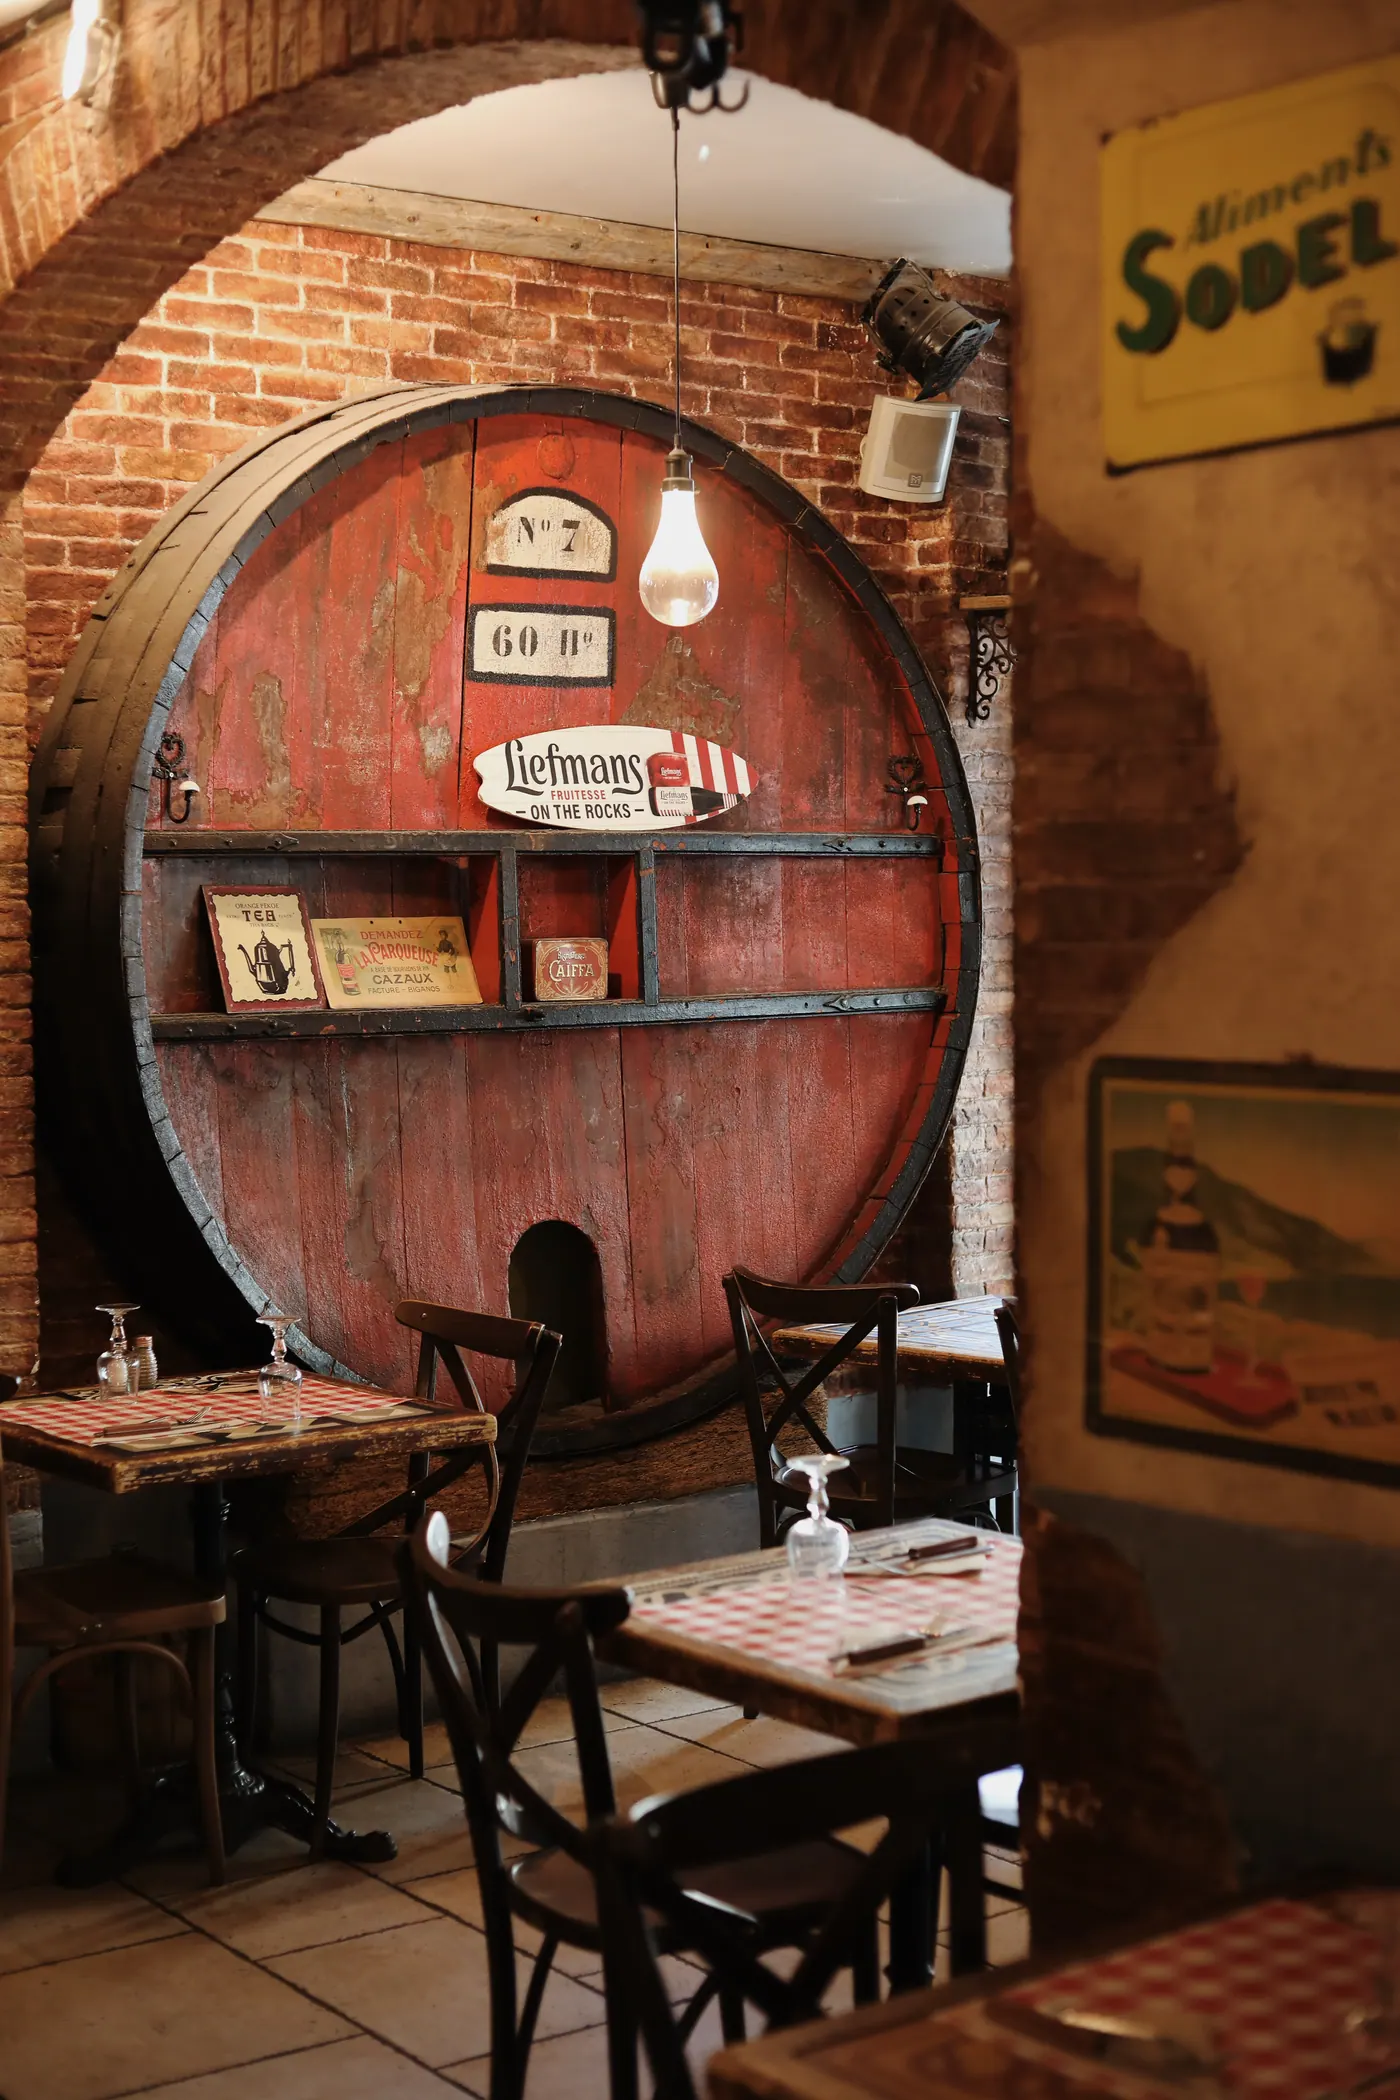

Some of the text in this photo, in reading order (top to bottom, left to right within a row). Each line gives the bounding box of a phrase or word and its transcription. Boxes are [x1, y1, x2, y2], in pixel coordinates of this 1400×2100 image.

[1184, 128, 1392, 251] Aliments
[1115, 197, 1400, 358] SODEL
[562, 519, 580, 551] 7
[492, 625, 538, 657] 60
[505, 739, 644, 796] Liefmans
[551, 790, 606, 800] FRUITESSE
[530, 803, 631, 819] ON THE ROCKS
[241, 910, 277, 922] TEA
[360, 930, 424, 940] DEMANDEZ
[353, 951, 373, 970] LA
[372, 973, 433, 985] CAZAUX
[407, 985, 441, 993] BIGANOS
